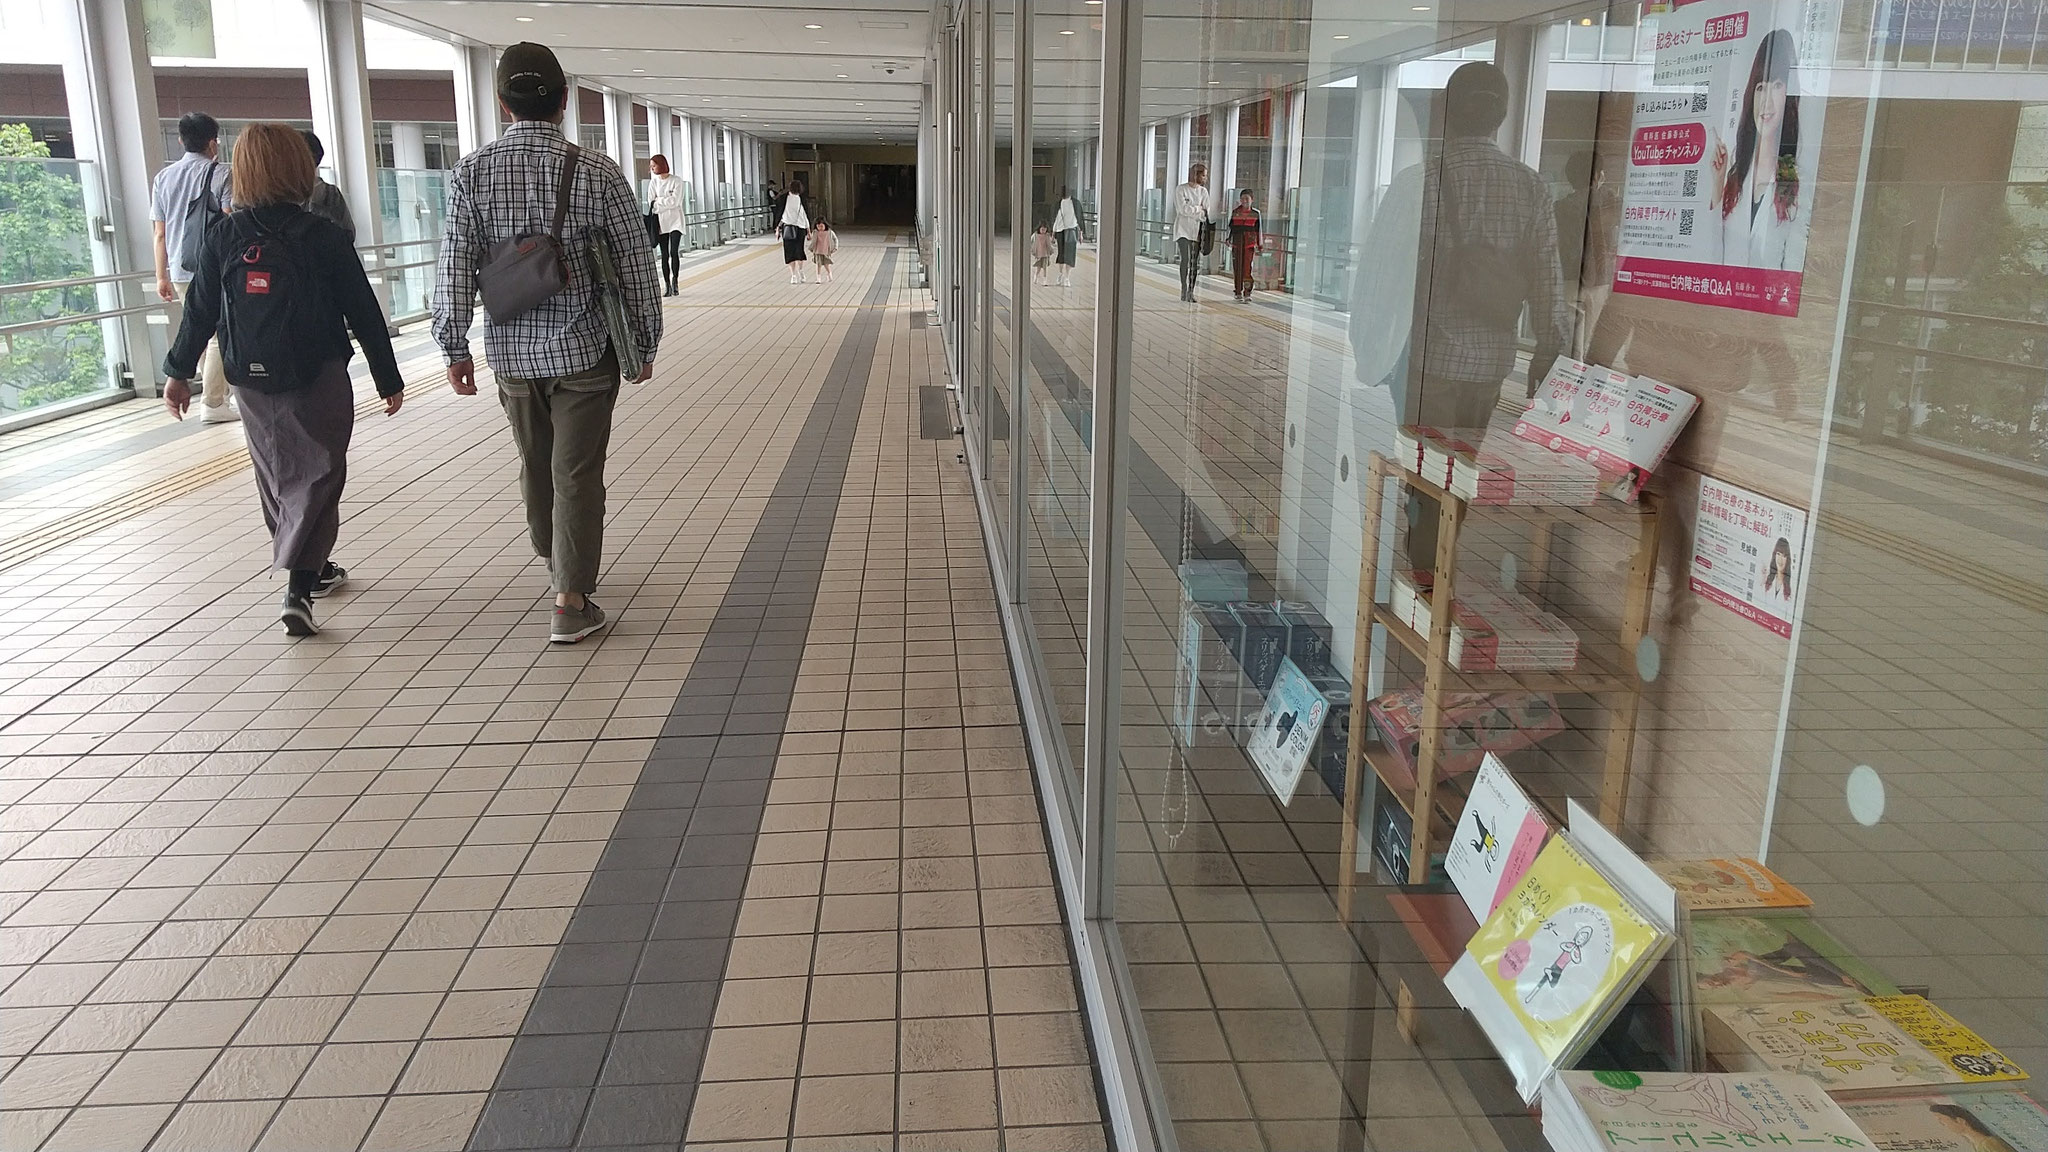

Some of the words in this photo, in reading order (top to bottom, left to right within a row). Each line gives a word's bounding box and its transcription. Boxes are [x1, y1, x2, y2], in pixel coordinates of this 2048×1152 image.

[1705, 16, 1745, 41] 毎月開催
[1636, 98, 1683, 114] お申し込みはこちら
[1625, 206, 1677, 220] 白内障専門サイト
[1670, 275, 1732, 297] 白内障治療Q&A
[1588, 401, 1609, 416] Q&A
[1626, 399, 1670, 424] 白内障治療
[1629, 413, 1651, 429] Q&A
[1702, 484, 1775, 522] 白内障治療の基本から
[1526, 876, 1551, 905] 日めくり
[1517, 889, 1559, 937] ヨガカレンダー
[1954, 1055, 1990, 1075] 35
[1604, 1129, 1867, 1150] アーユルヴェーダ
